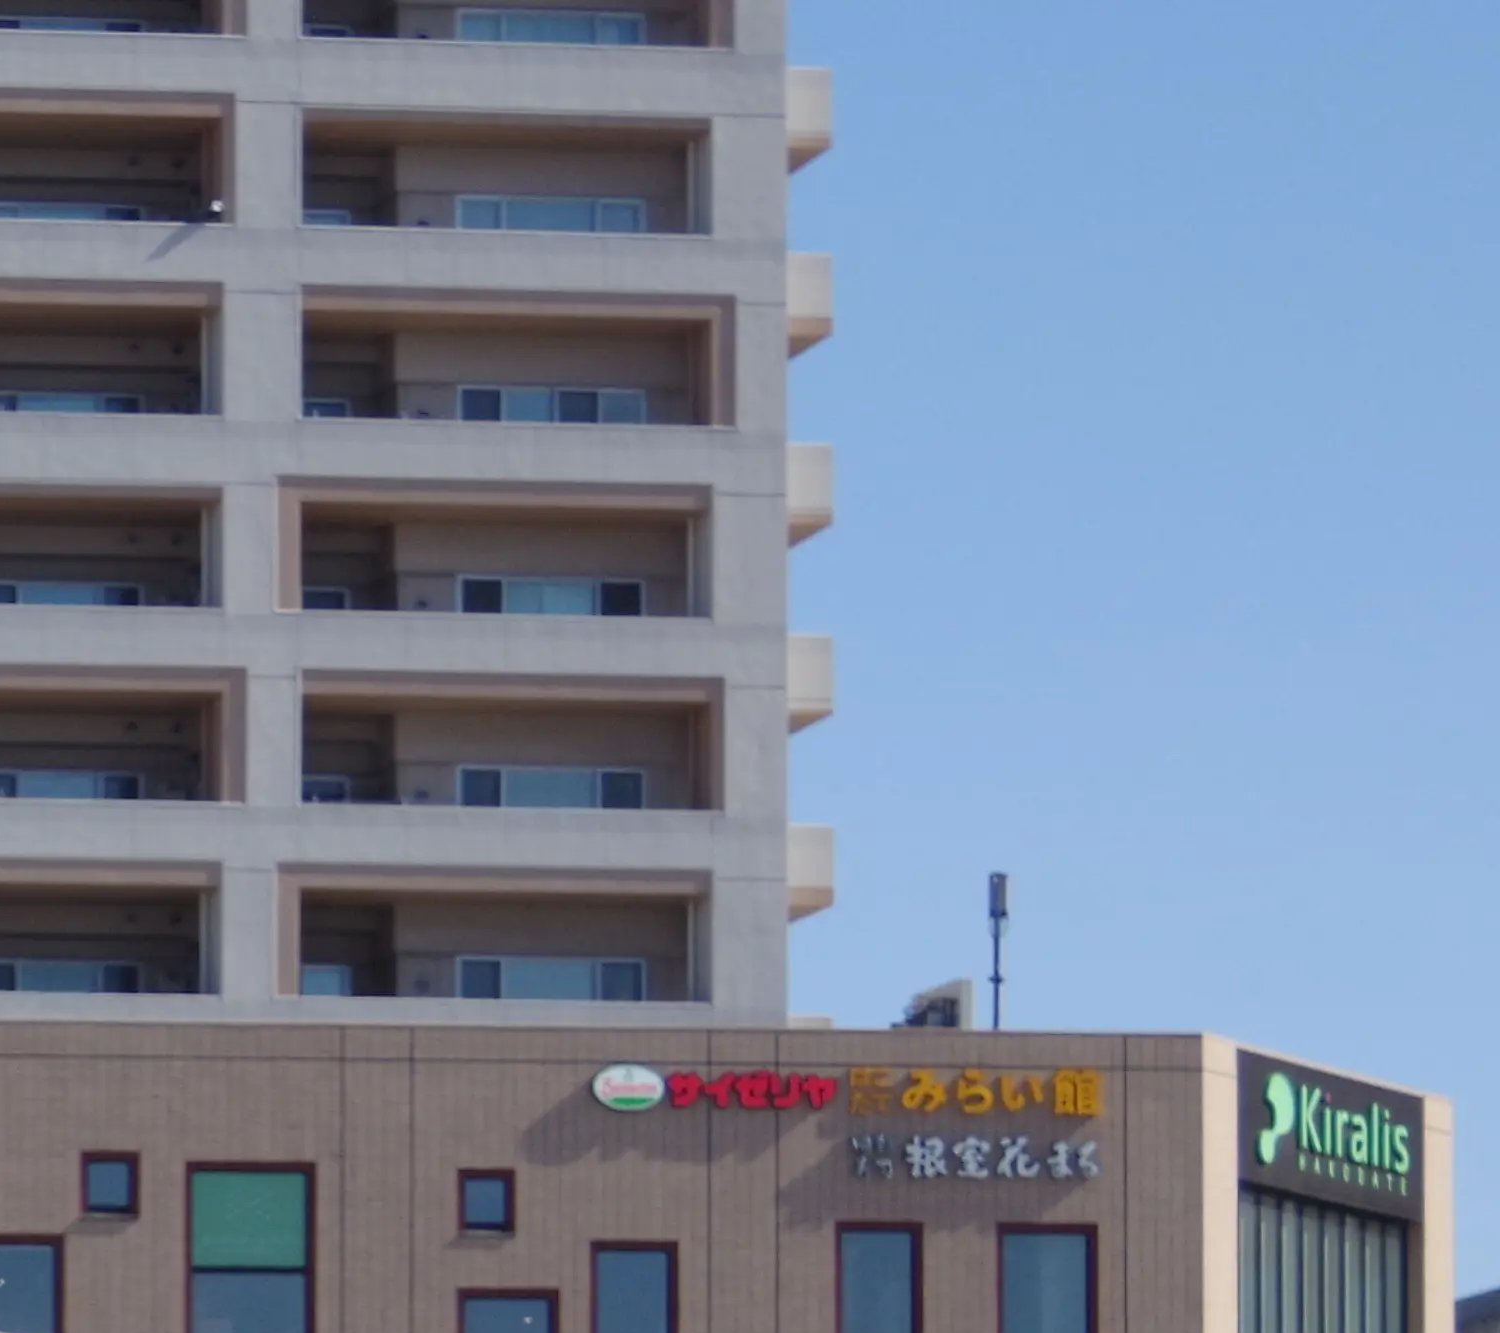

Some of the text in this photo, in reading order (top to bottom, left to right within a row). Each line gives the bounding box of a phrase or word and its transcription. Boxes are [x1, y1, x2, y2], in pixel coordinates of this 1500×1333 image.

[668, 1070, 838, 1110] サイゼリヤ
[902, 1067, 1102, 1117] みらい館
[1301, 1083, 1410, 1175] Kiralis
